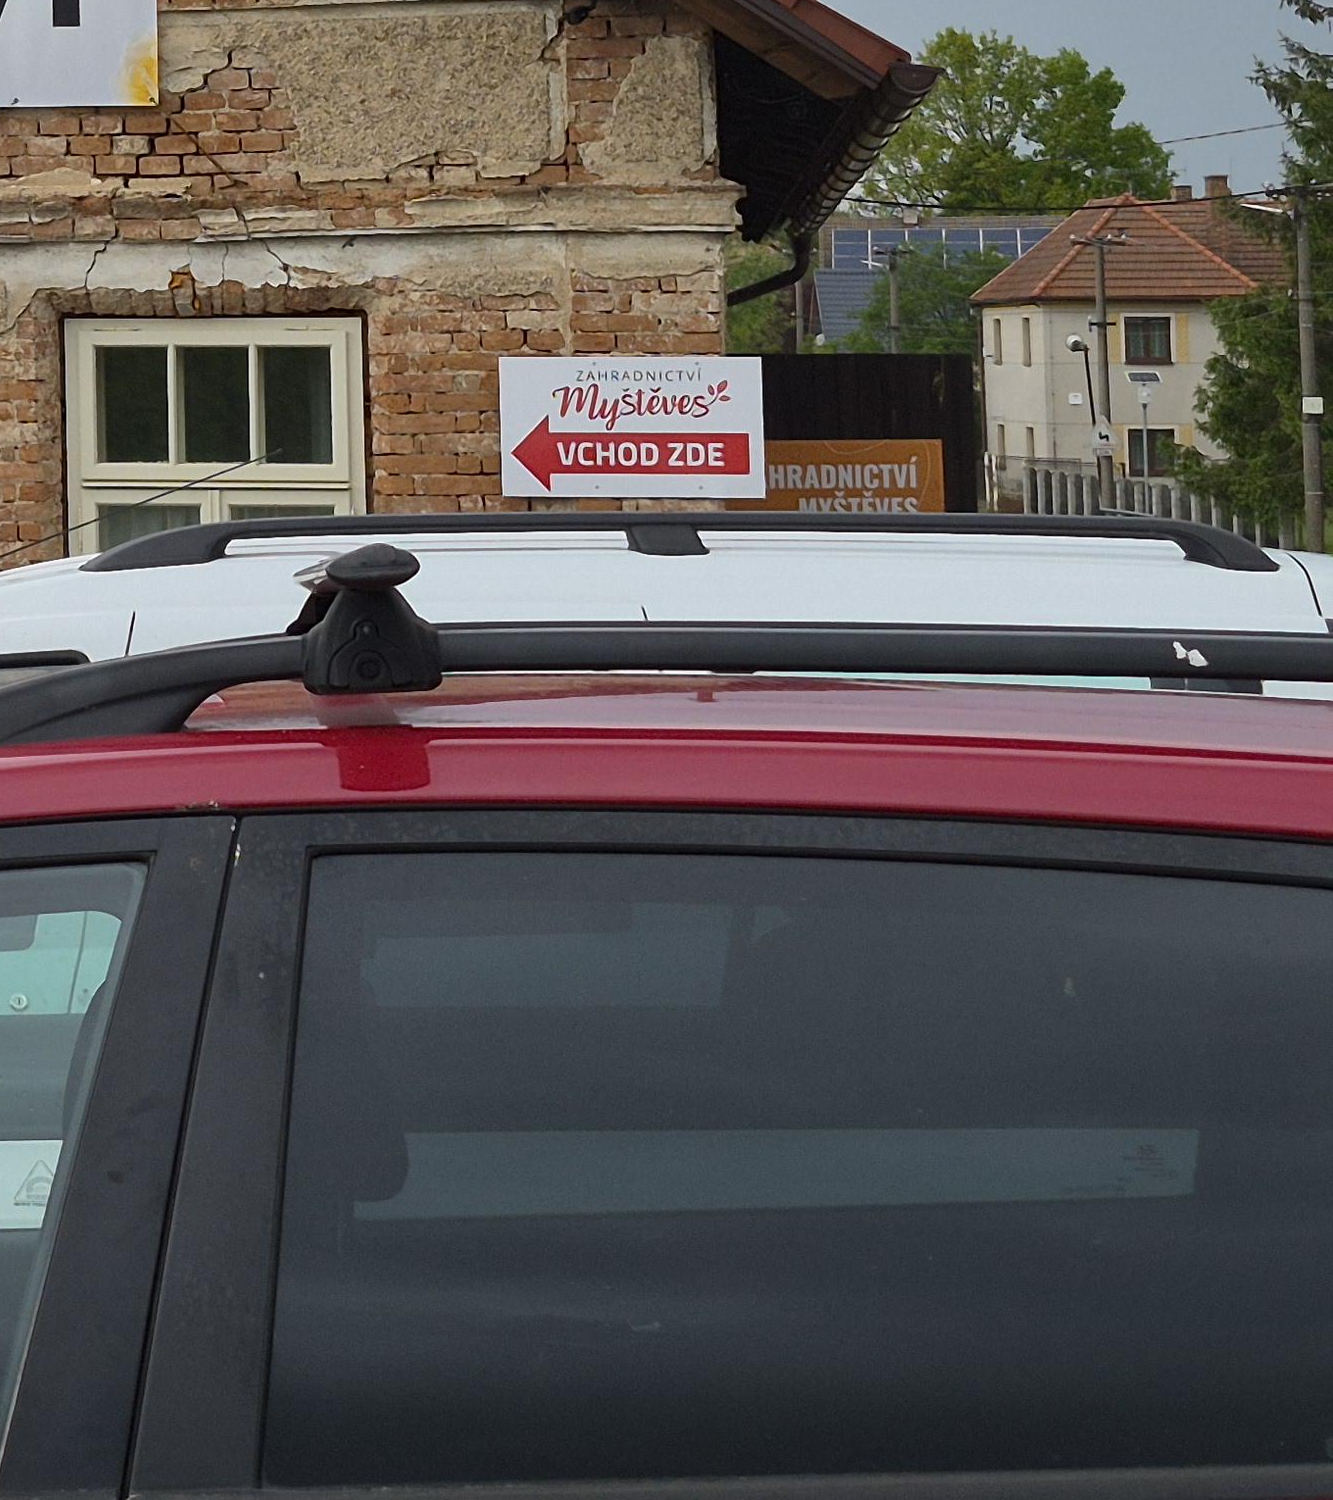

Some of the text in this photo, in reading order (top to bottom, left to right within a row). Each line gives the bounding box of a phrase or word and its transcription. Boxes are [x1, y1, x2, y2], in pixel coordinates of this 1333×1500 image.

[575, 367, 702, 382] ZAHRADNICTVÍ
[551, 383, 711, 431] Myštěves
[556, 441, 726, 467] VCHOD ZDE
[768, 455, 918, 489] HRADNICTVÍ
